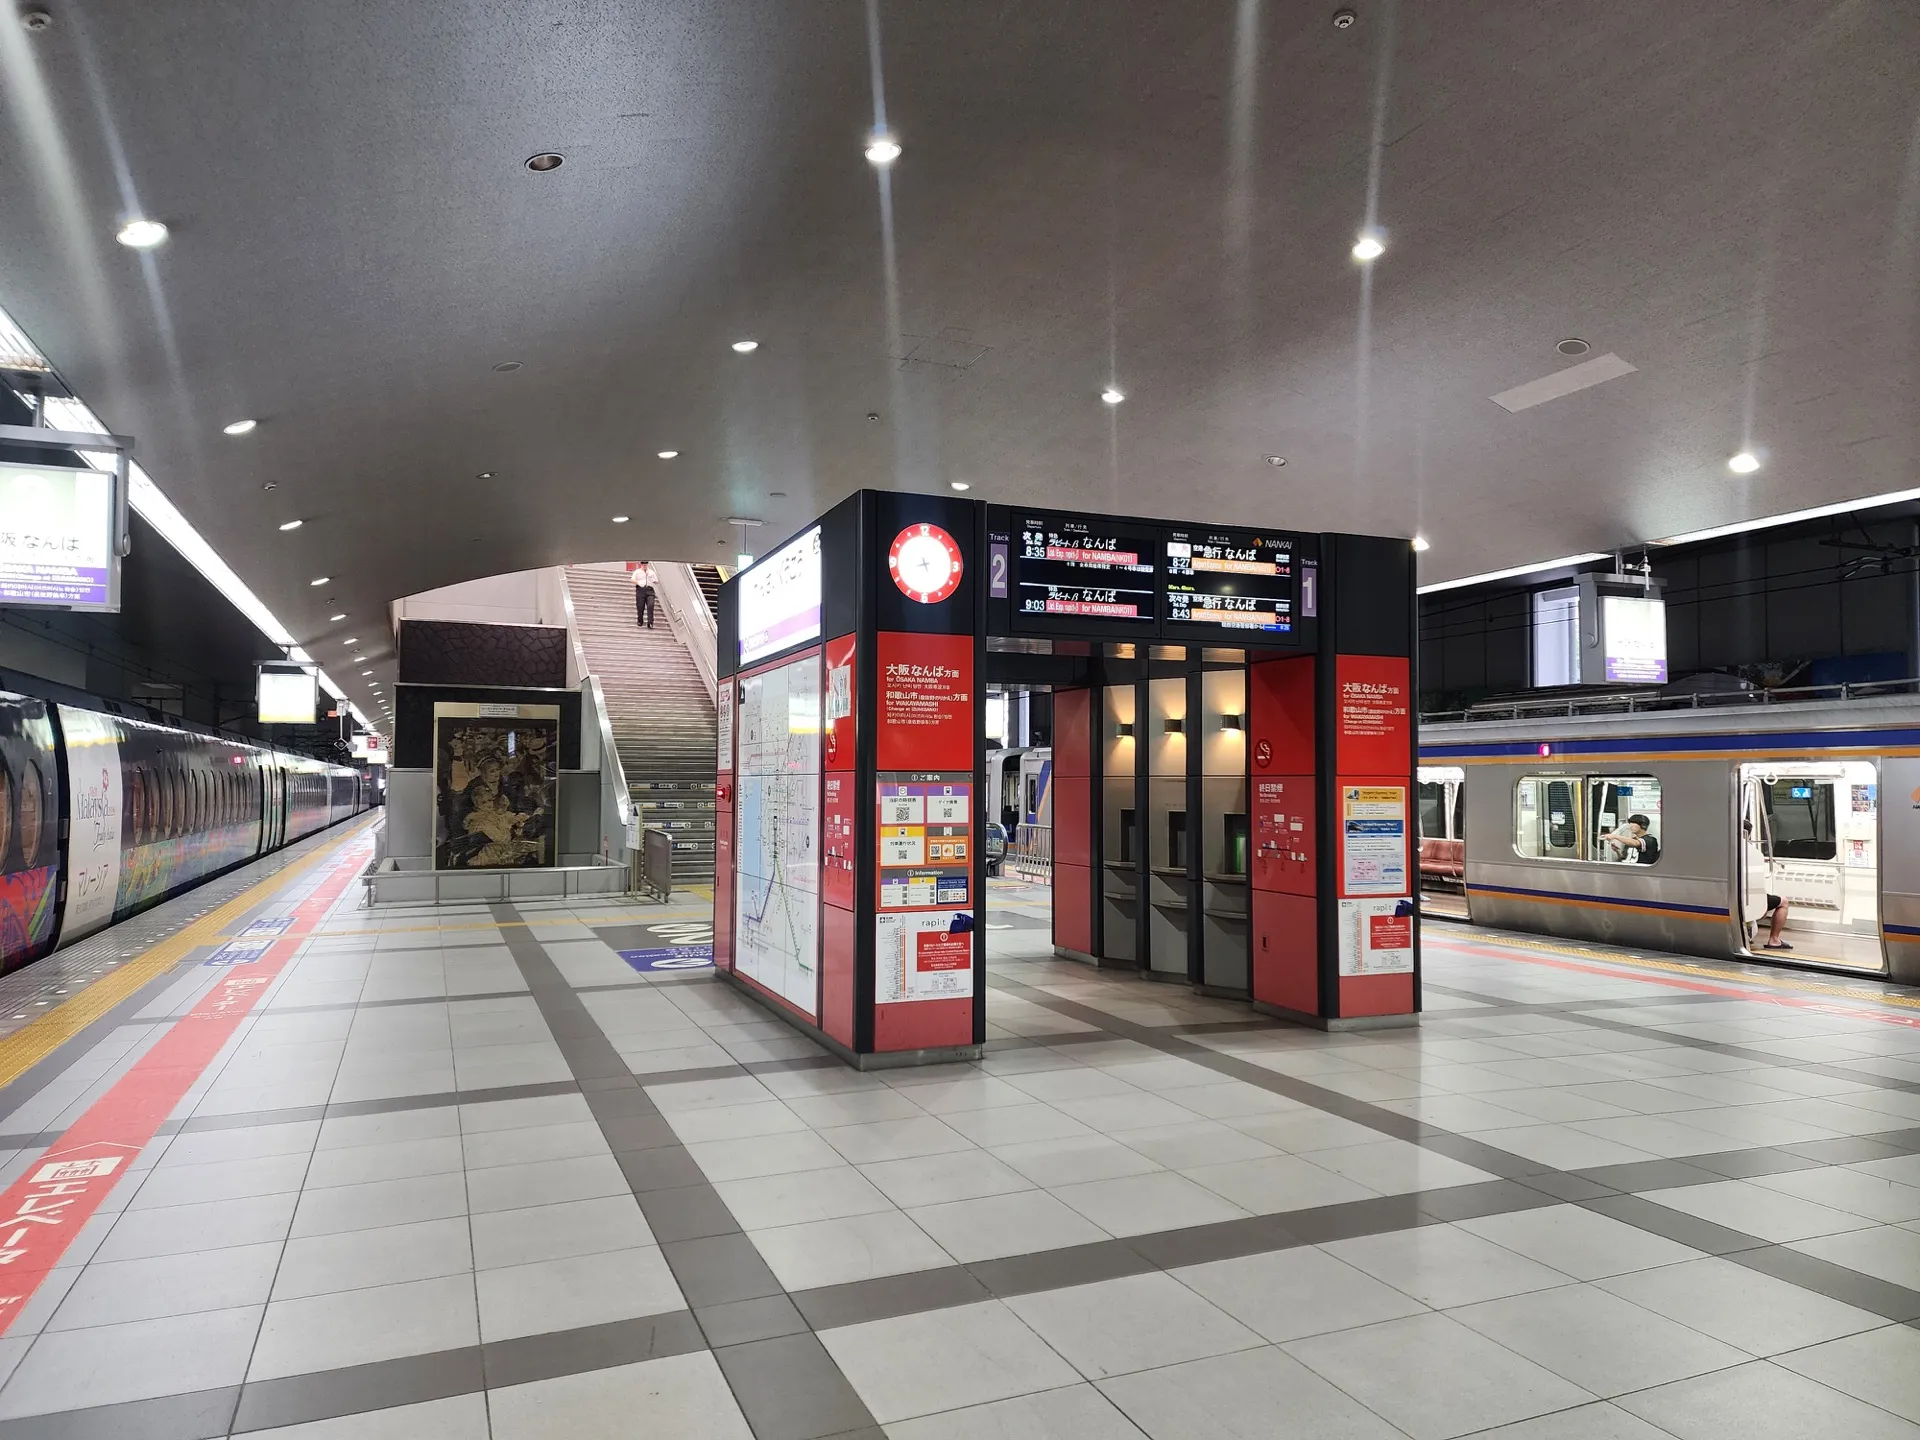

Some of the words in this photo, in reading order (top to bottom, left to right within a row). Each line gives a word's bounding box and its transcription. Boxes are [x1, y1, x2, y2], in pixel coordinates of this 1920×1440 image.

[920, 525, 929, 537] 12
[989, 533, 1010, 542] Track
[1083, 536, 1116, 551] なんば
[1265, 540, 1292, 549] NANKAI
[1026, 546, 1045, 558] 8:35
[1225, 549, 1256, 560] なんば
[952, 562, 958, 572] 3
[1172, 557, 1190, 567] 8:27
[992, 554, 1006, 589] 2
[1083, 589, 1116, 602] なんば
[1303, 577, 1312, 609] 1
[1025, 600, 1045, 611] 9:03
[1225, 600, 1256, 611] なんば
[1172, 609, 1190, 619] 8:43
[920, 774, 940, 782] ご案内
